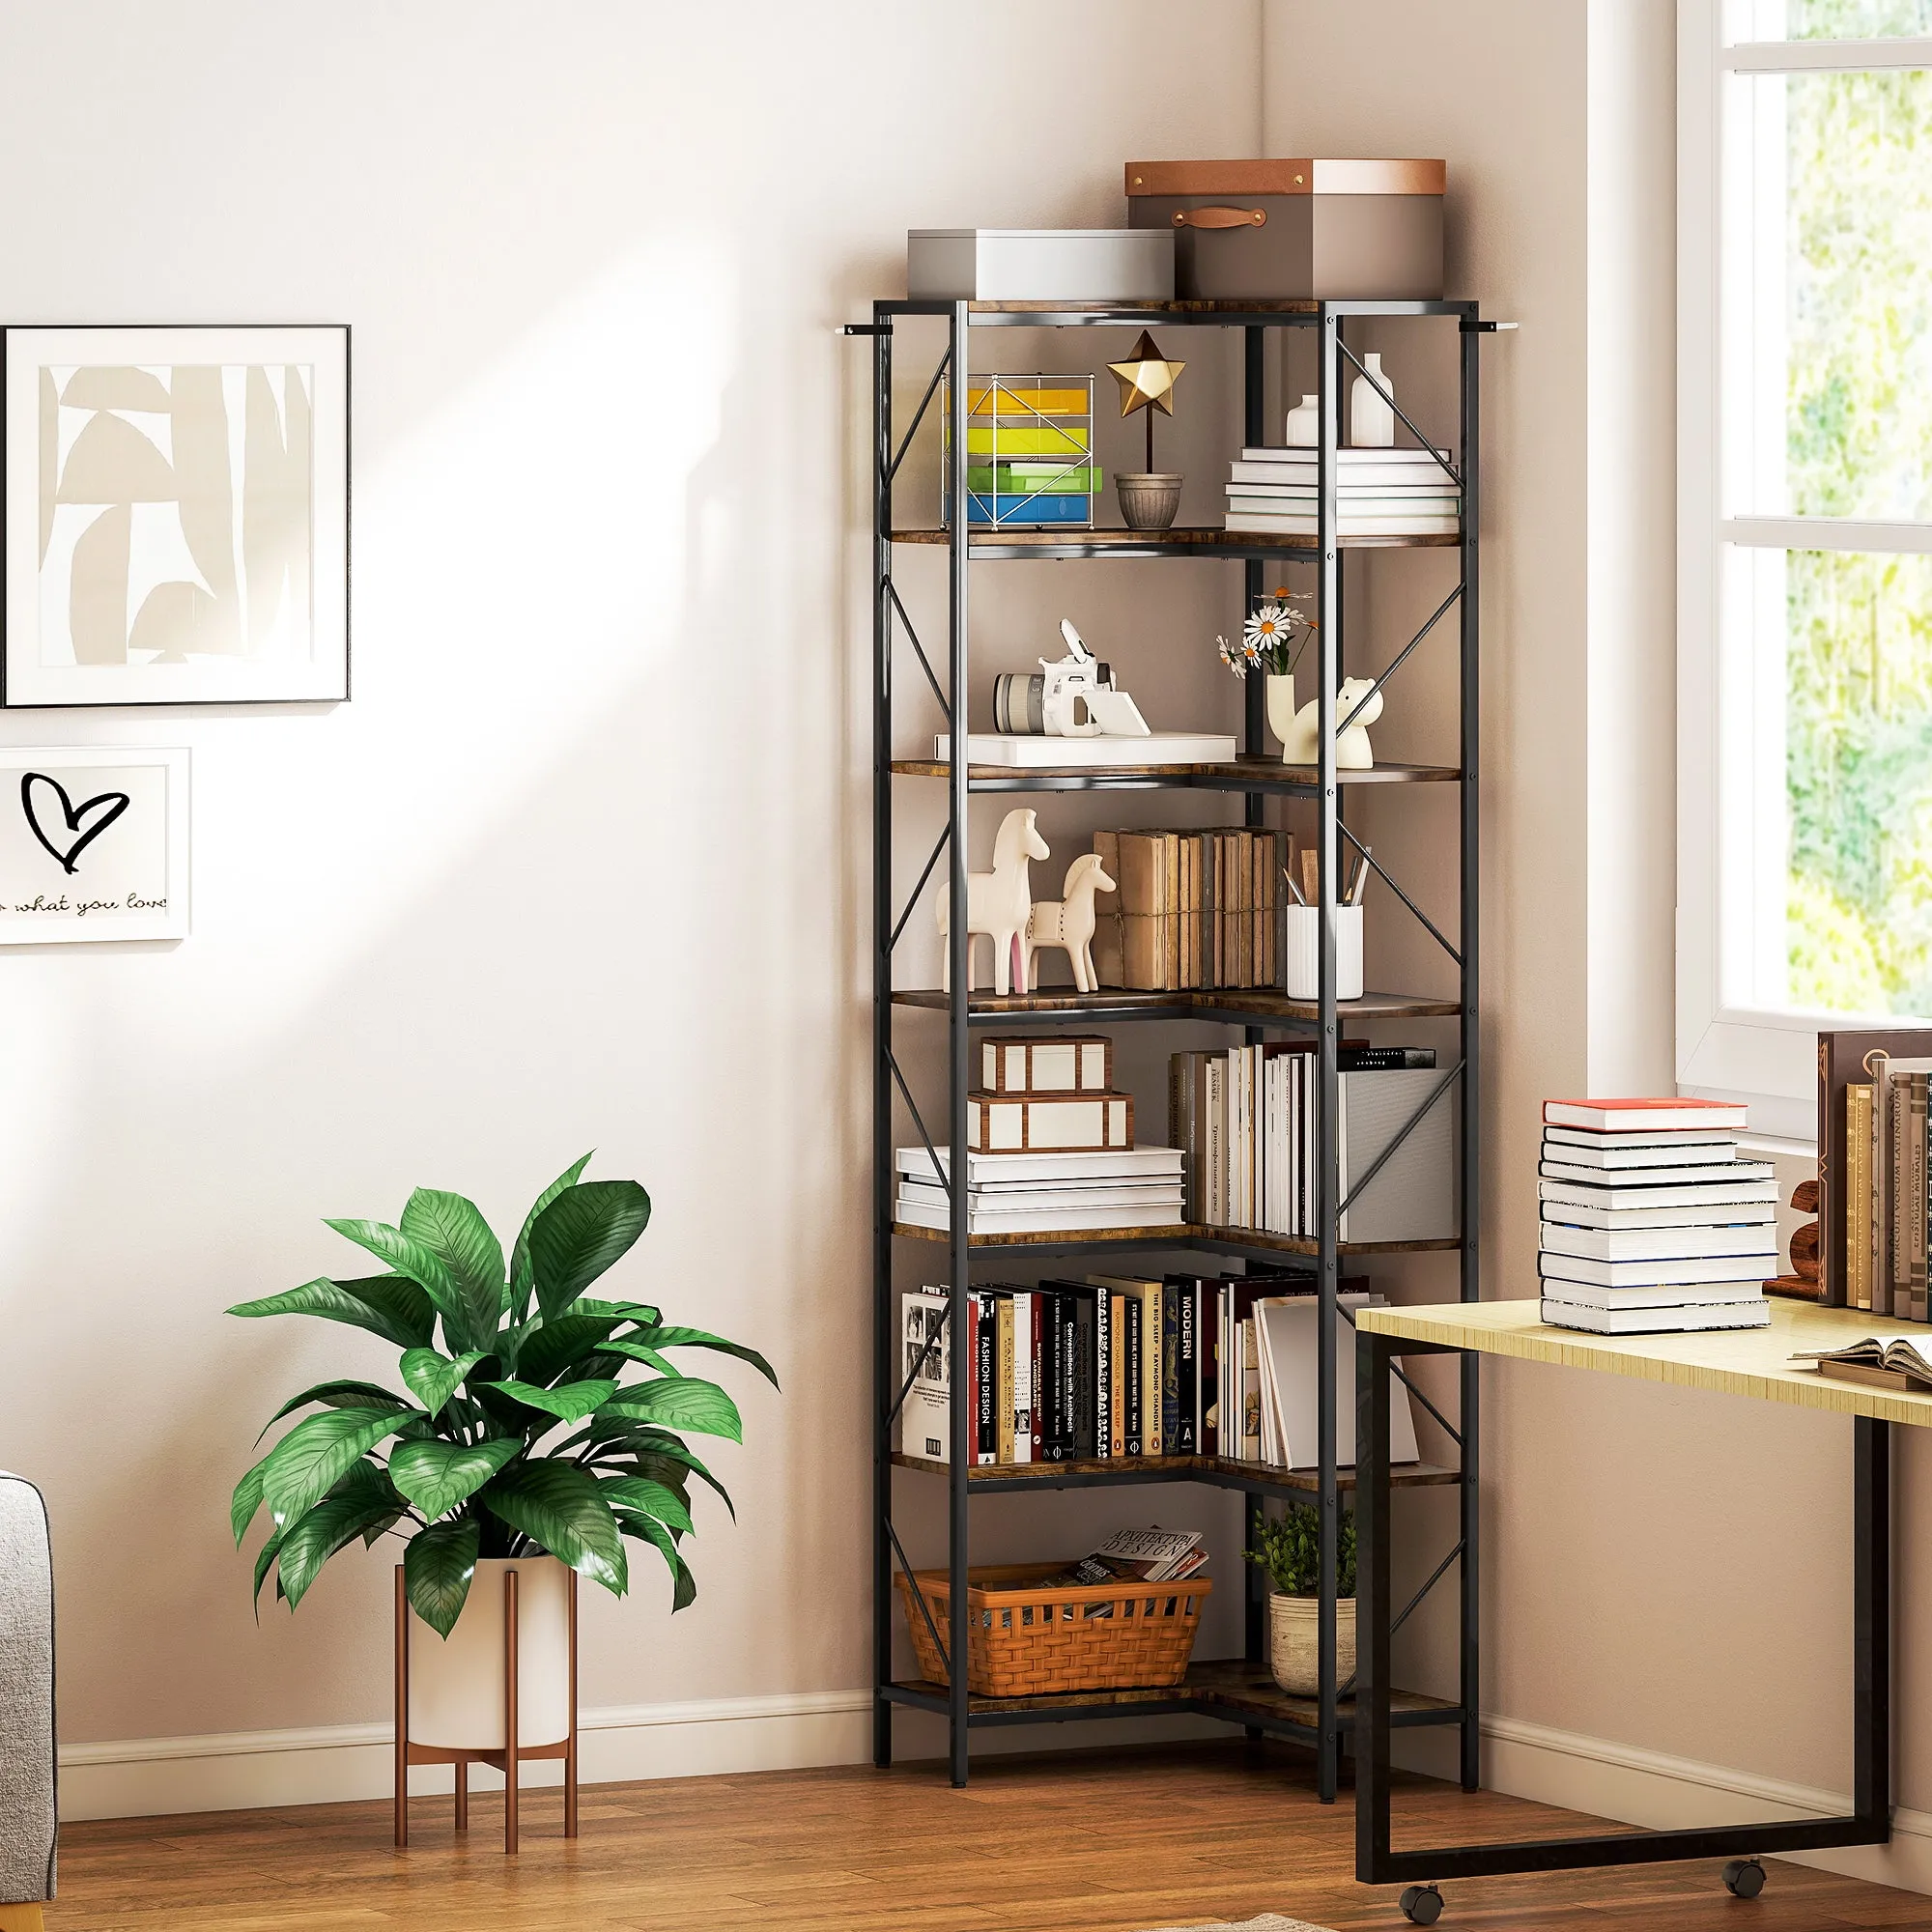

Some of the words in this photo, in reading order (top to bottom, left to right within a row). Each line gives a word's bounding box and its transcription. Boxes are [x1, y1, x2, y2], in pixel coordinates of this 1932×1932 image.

[14, 895, 71, 912] what
[76, 900, 120, 917] you
[1182, 1295, 1192, 1359] MODERN
[981, 1336, 990, 1382] FASHION
[981, 1385, 990, 1424] DESIGN
[1103, 1540, 1182, 1557] DESIGN
[1079, 1557, 1111, 1577] domus
